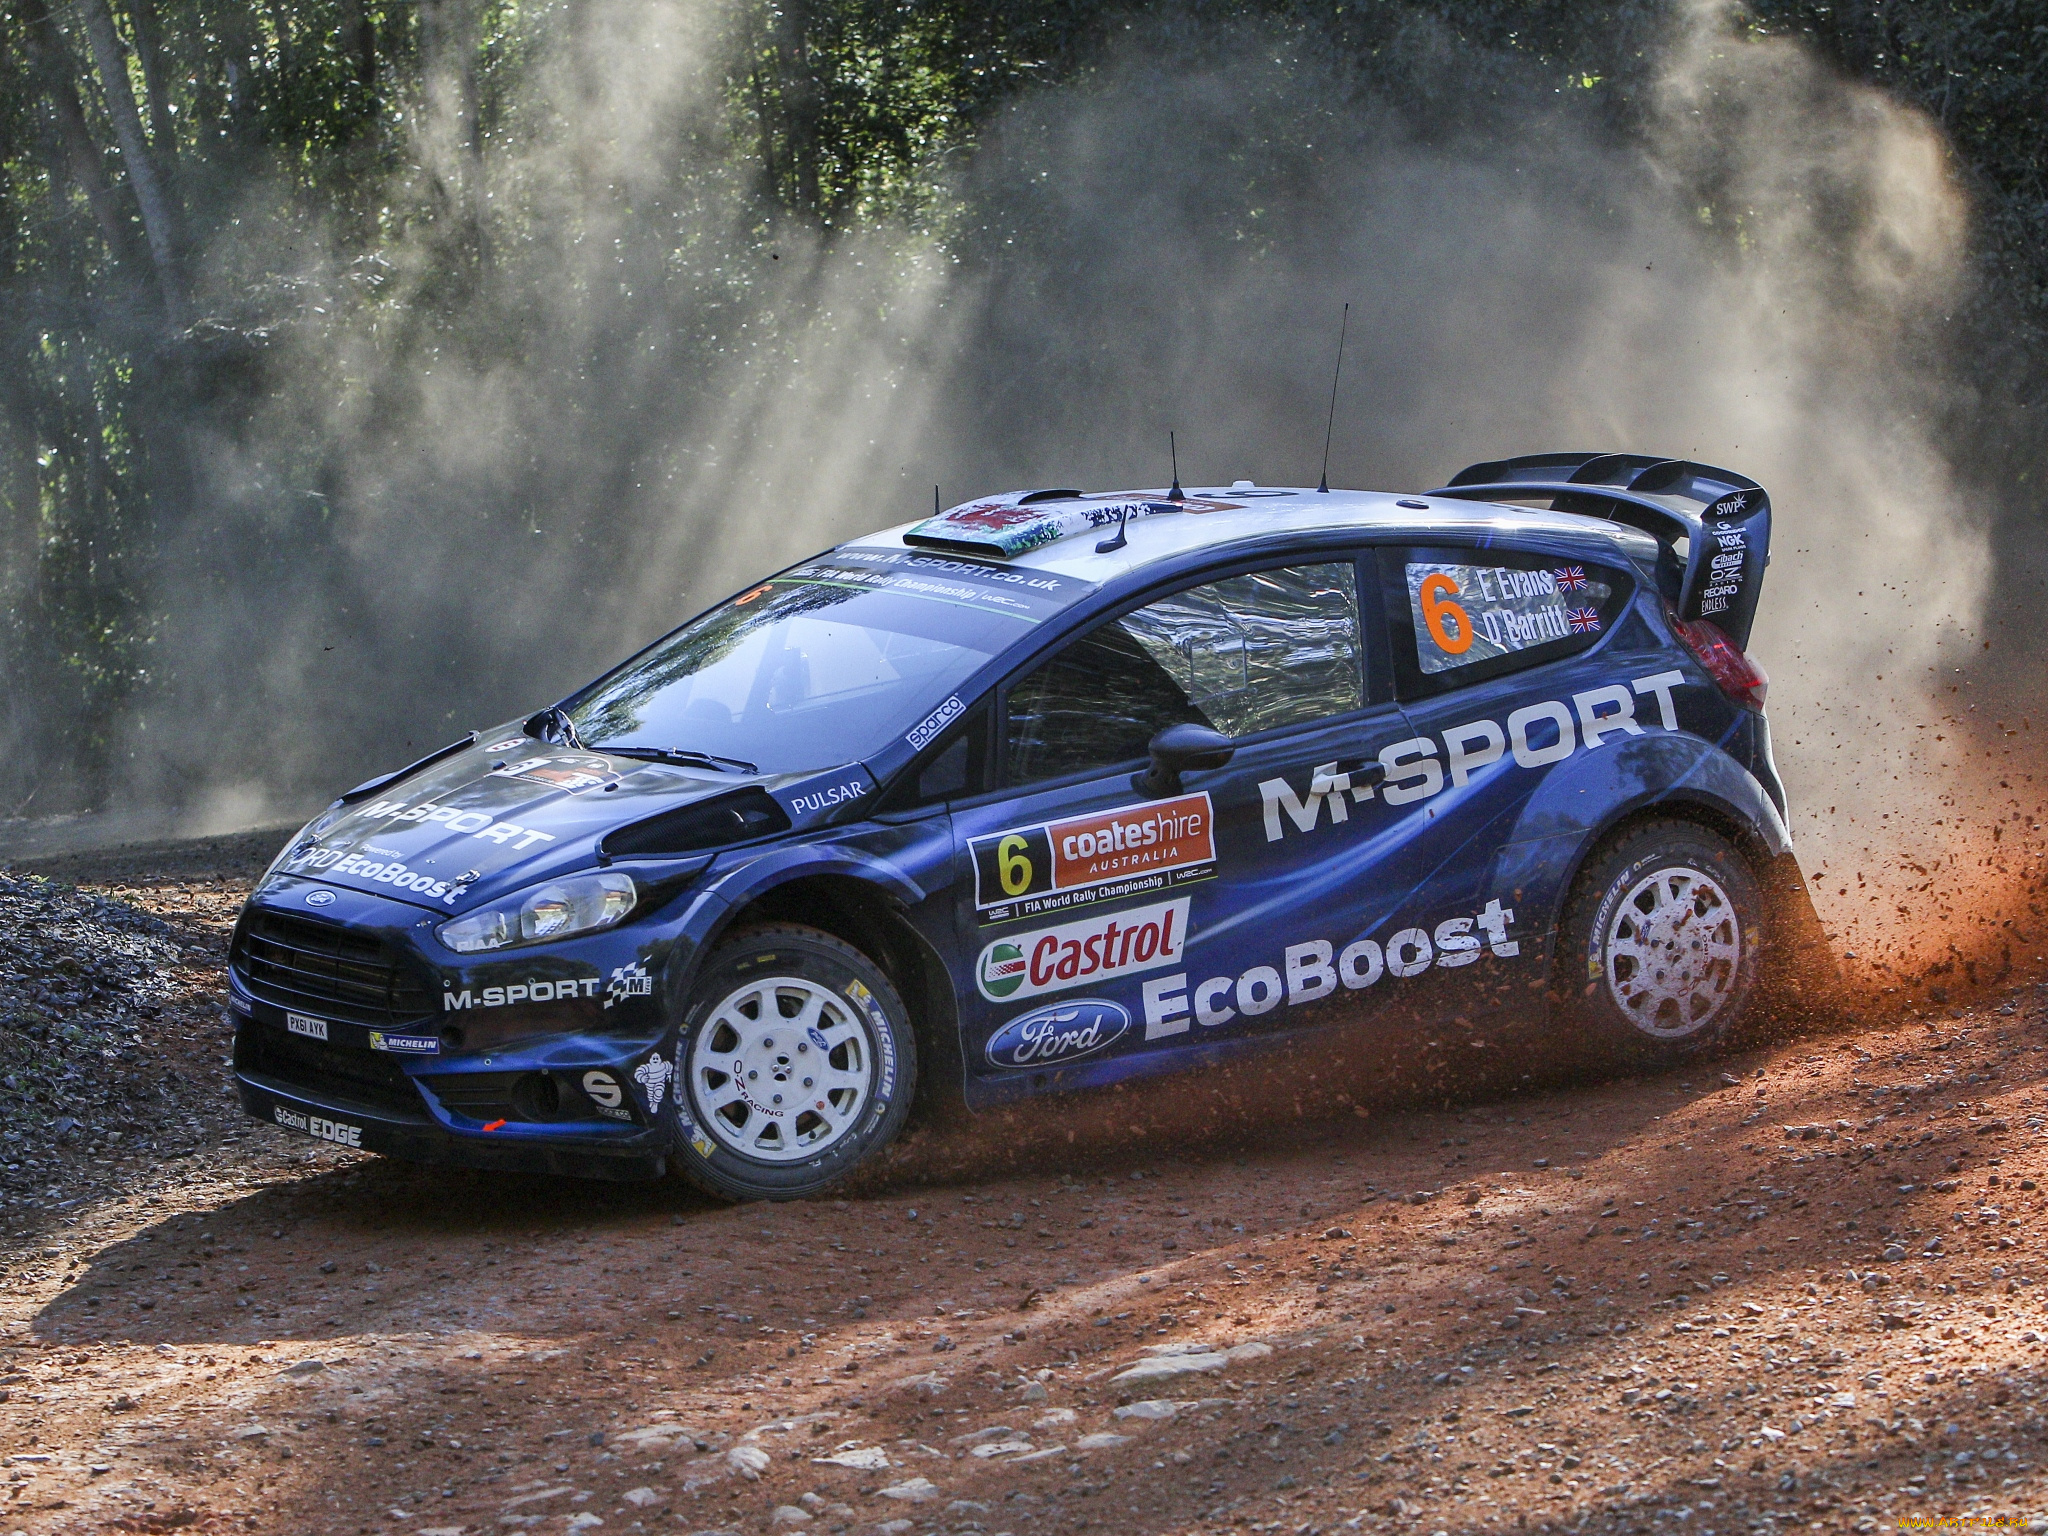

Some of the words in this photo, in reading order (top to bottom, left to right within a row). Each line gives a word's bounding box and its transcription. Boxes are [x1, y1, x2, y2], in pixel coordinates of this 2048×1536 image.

[1717, 501, 1741, 515] SWP
[1717, 533, 1745, 548] NGK
[1711, 550, 1744, 570] Eibach
[735, 585, 773, 606] 6
[835, 571, 865, 583] World
[863, 574, 897, 588] Rally
[894, 577, 975, 600] Championship
[1476, 569, 1497, 603] E
[1495, 566, 1554, 600] Evans
[1704, 584, 1738, 599] RECARO
[1420, 573, 1474, 655] 6
[1702, 596, 1727, 613] ENDLESS
[1482, 611, 1503, 645] D
[1501, 604, 1569, 643] Barritt
[909, 698, 961, 746] sparco
[1258, 670, 1687, 842] M-SPORT
[791, 781, 866, 815] PULSAR
[354, 800, 557, 850] M-SPORT
[1062, 810, 1202, 861] coateshire
[998, 835, 1033, 896] 6
[1089, 846, 1179, 874] AUSTRALIA
[1025, 901, 1042, 913] FIA
[1042, 895, 1071, 910] World
[1073, 890, 1097, 903] Rally
[1099, 874, 1163, 898] Championship
[1592, 870, 1631, 945] MICHELIN
[1029, 908, 1175, 987] Castrol
[1142, 899, 1520, 1041] EcoBoost
[444, 978, 600, 1011] M-SPORT
[290, 1016, 307, 1033] PX61
[310, 1021, 325, 1037] AYK
[387, 1038, 437, 1049] MICHELIN
[1013, 1010, 1103, 1063] Ford
[871, 1010, 896, 1098] MICHELIN
[741, 1091, 784, 1117] RACING
[281, 1108, 308, 1131] Castrol
[309, 1116, 362, 1147] EDGE
